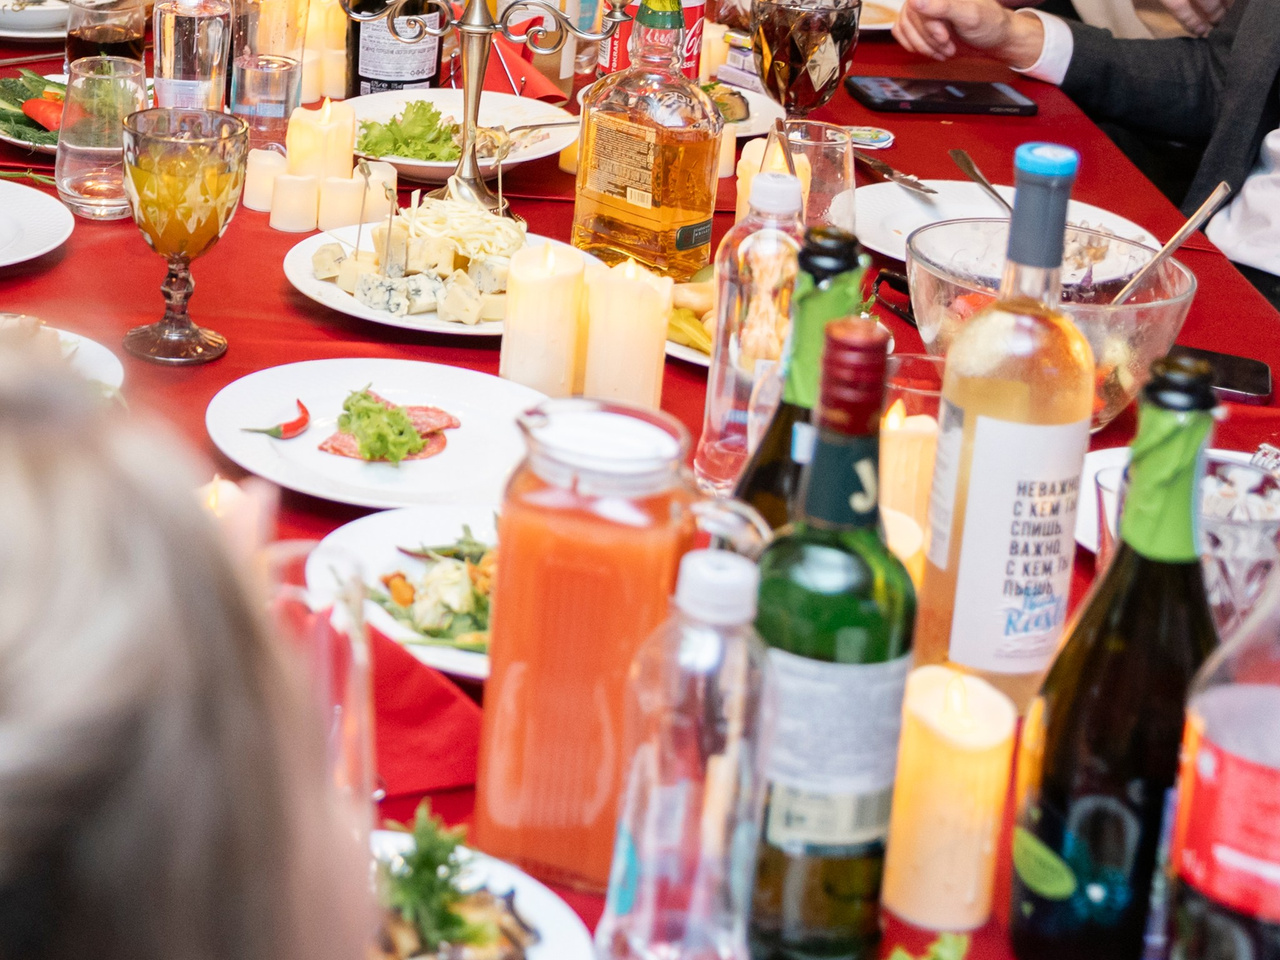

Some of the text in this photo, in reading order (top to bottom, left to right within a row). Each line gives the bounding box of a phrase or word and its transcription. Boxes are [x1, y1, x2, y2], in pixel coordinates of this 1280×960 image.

[1013, 500, 1022, 517] С
[1029, 501, 1060, 517] КЕМ
[1010, 520, 1062, 536] СПИШЬ
[1009, 539, 1060, 556] ВАЖНО
[1005, 559, 1015, 576] С
[1022, 560, 1053, 577] КЕМ
